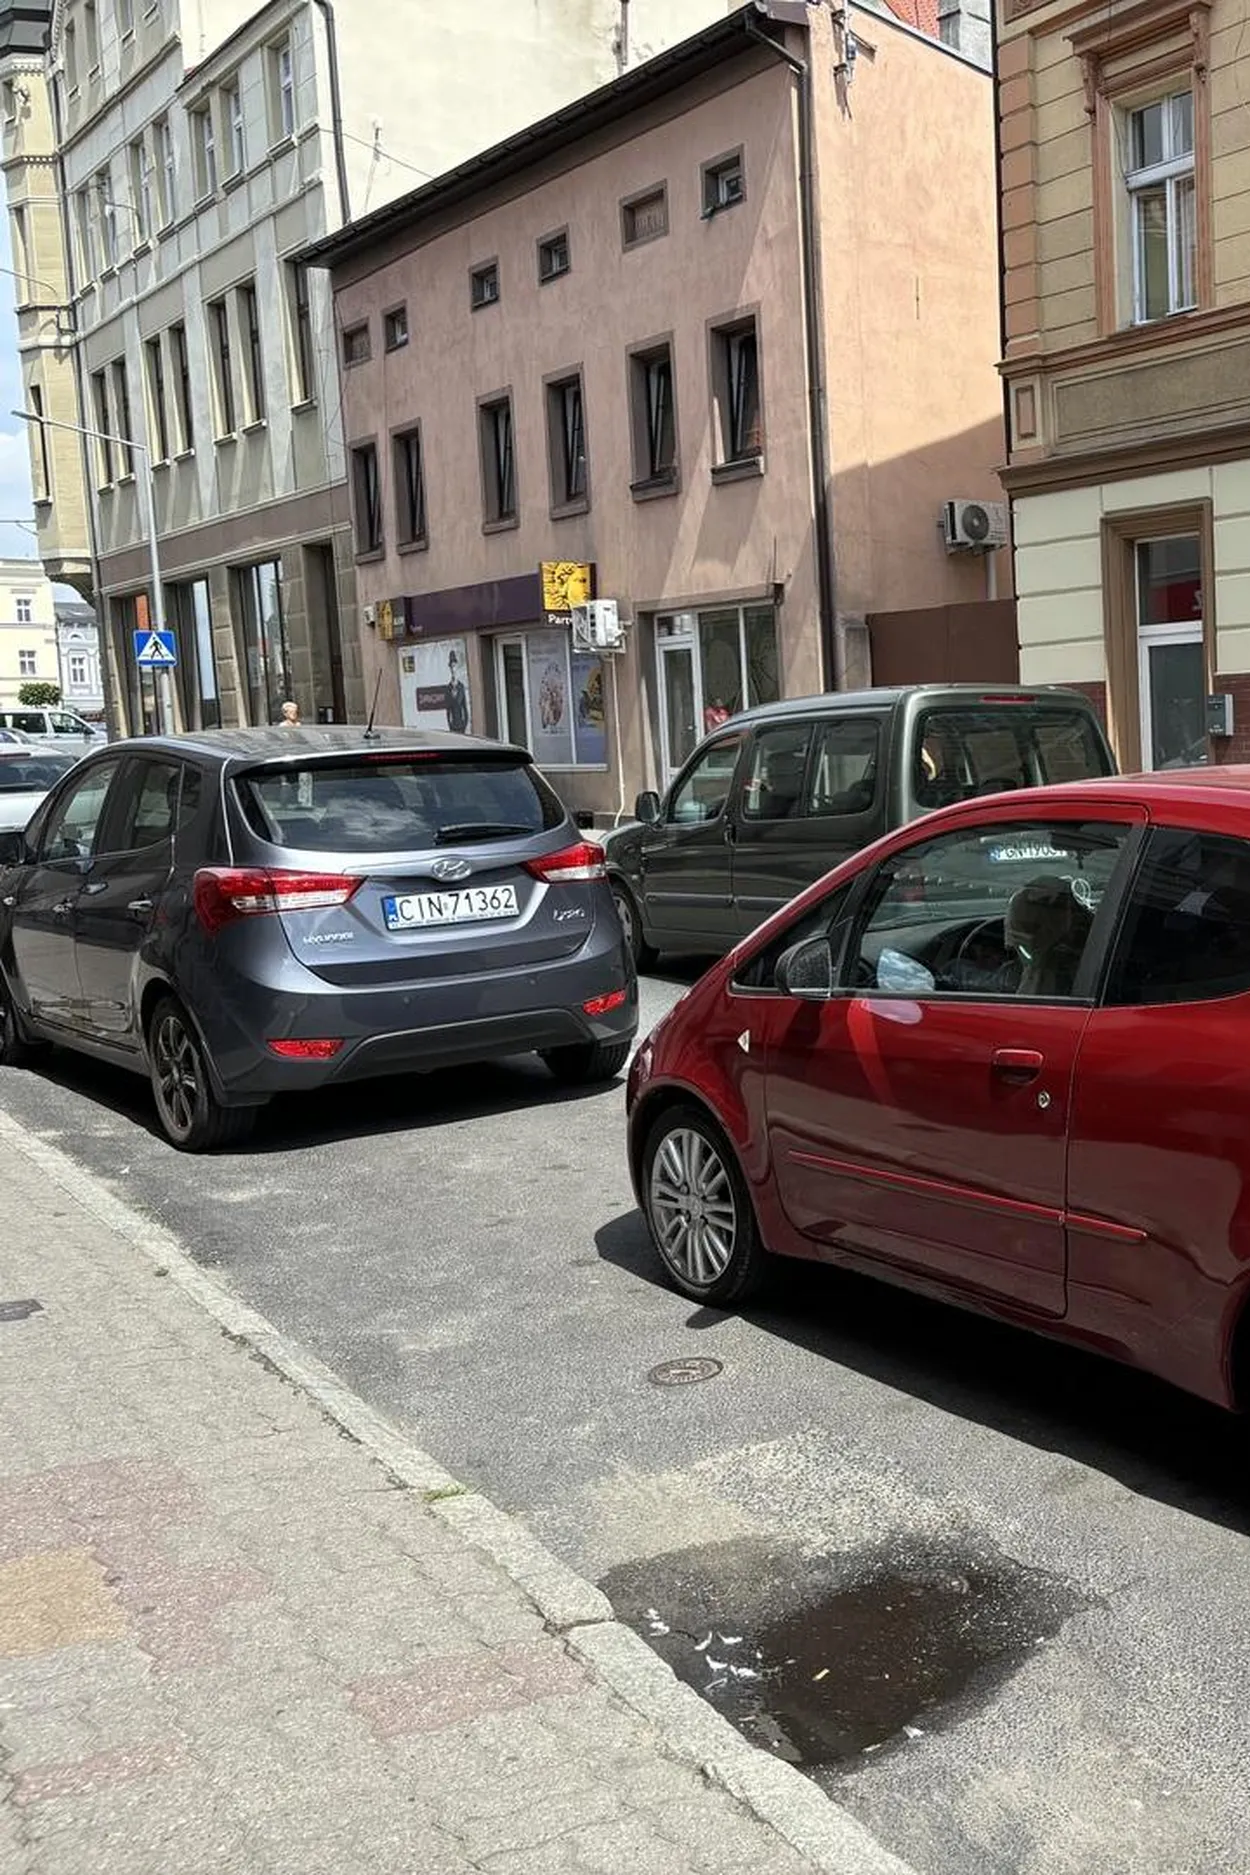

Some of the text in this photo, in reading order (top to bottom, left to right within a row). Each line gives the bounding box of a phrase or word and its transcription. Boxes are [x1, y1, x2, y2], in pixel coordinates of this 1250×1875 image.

[548, 613, 572, 625] Part
[399, 888, 514, 921] CIN 71362
